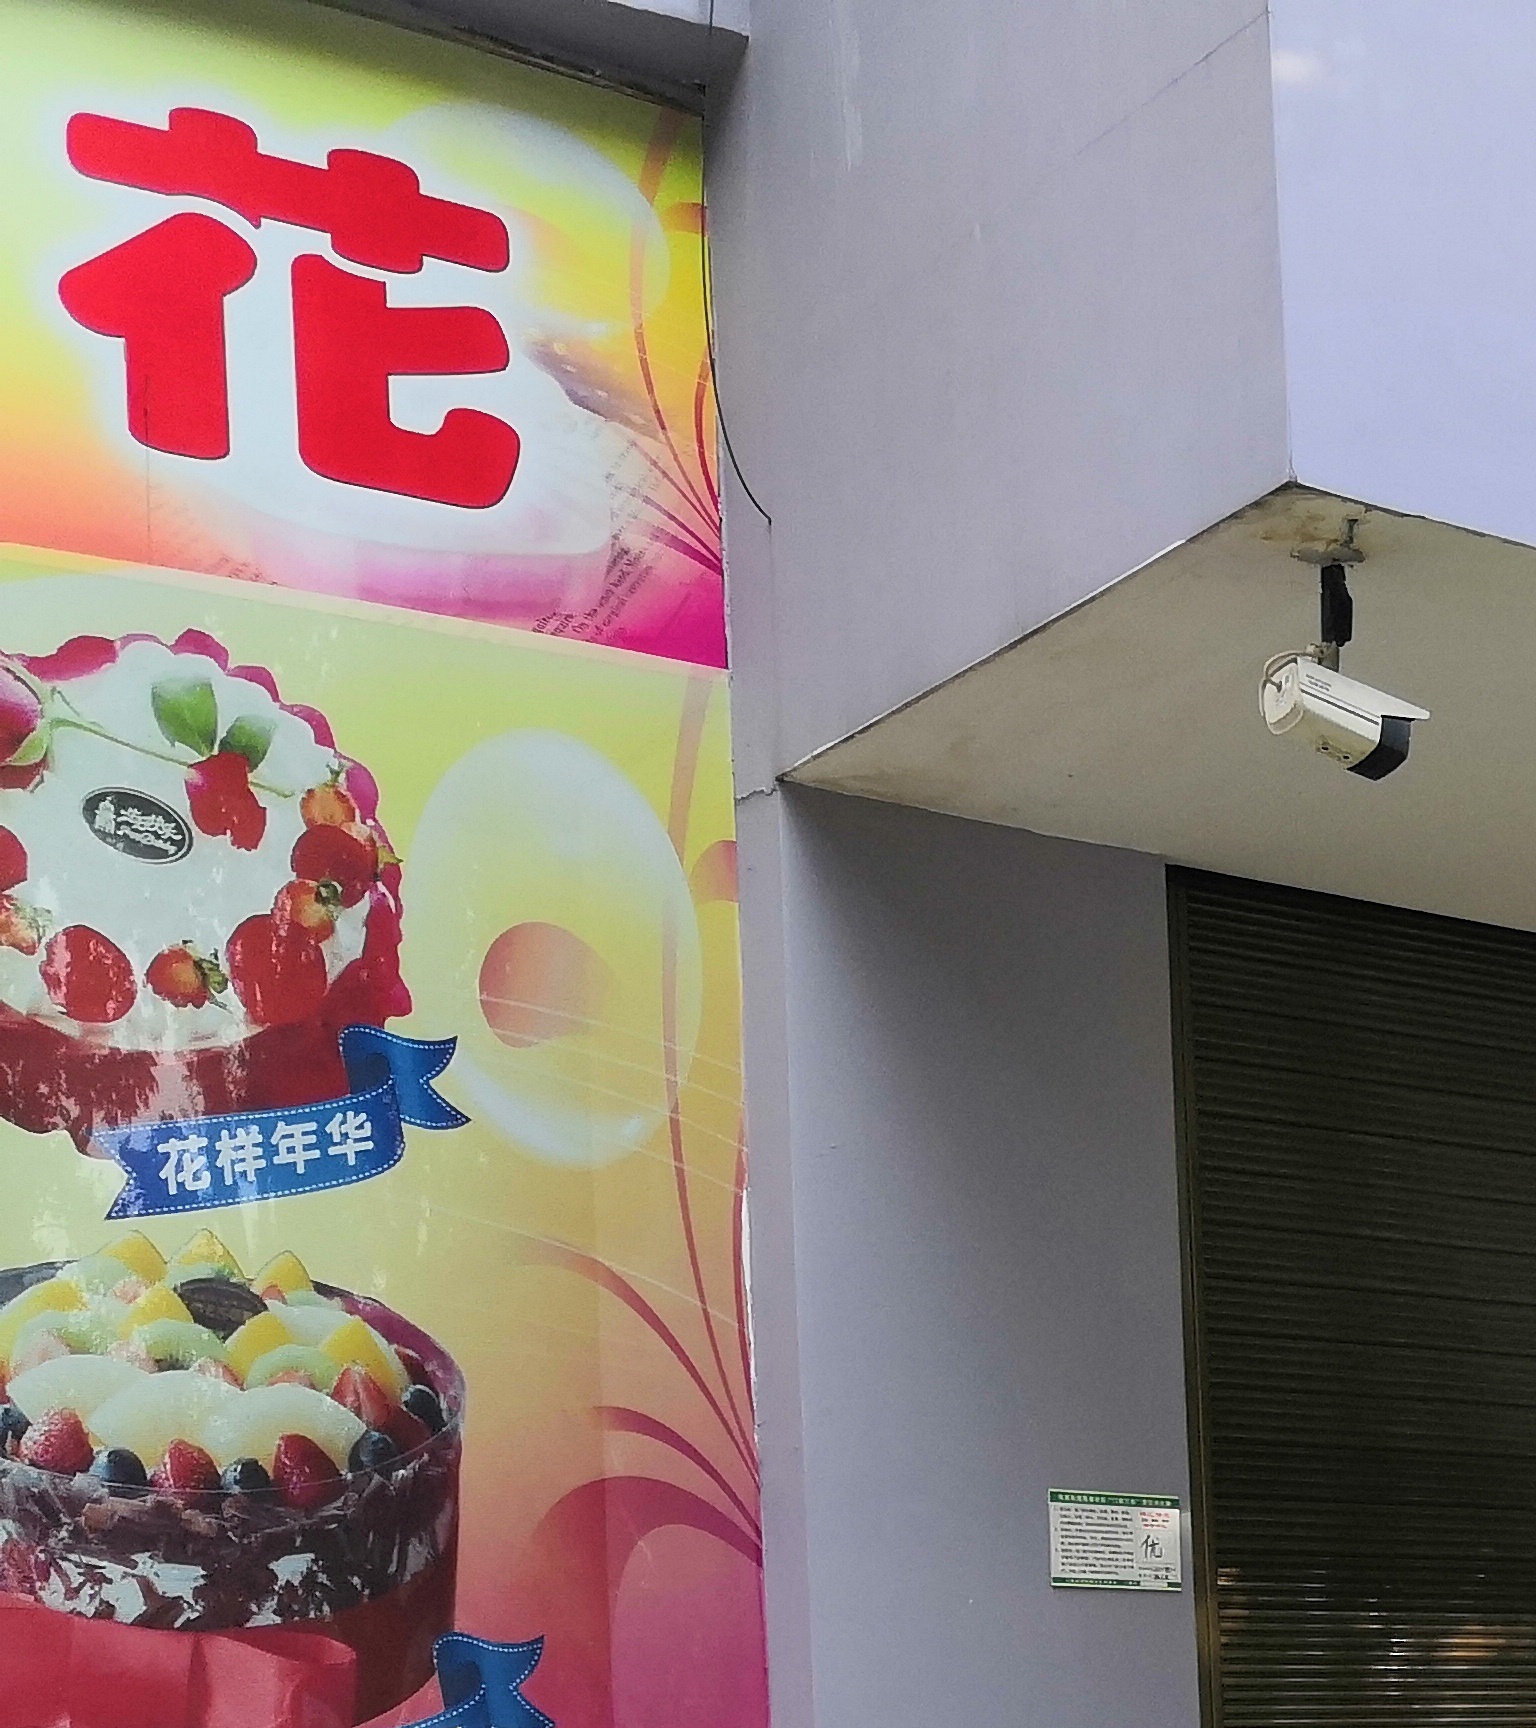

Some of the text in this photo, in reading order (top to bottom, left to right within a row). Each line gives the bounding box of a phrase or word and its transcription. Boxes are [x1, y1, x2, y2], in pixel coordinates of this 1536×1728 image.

[58, 106, 521, 509] 花
[156, 1109, 376, 1197] 花样年华
